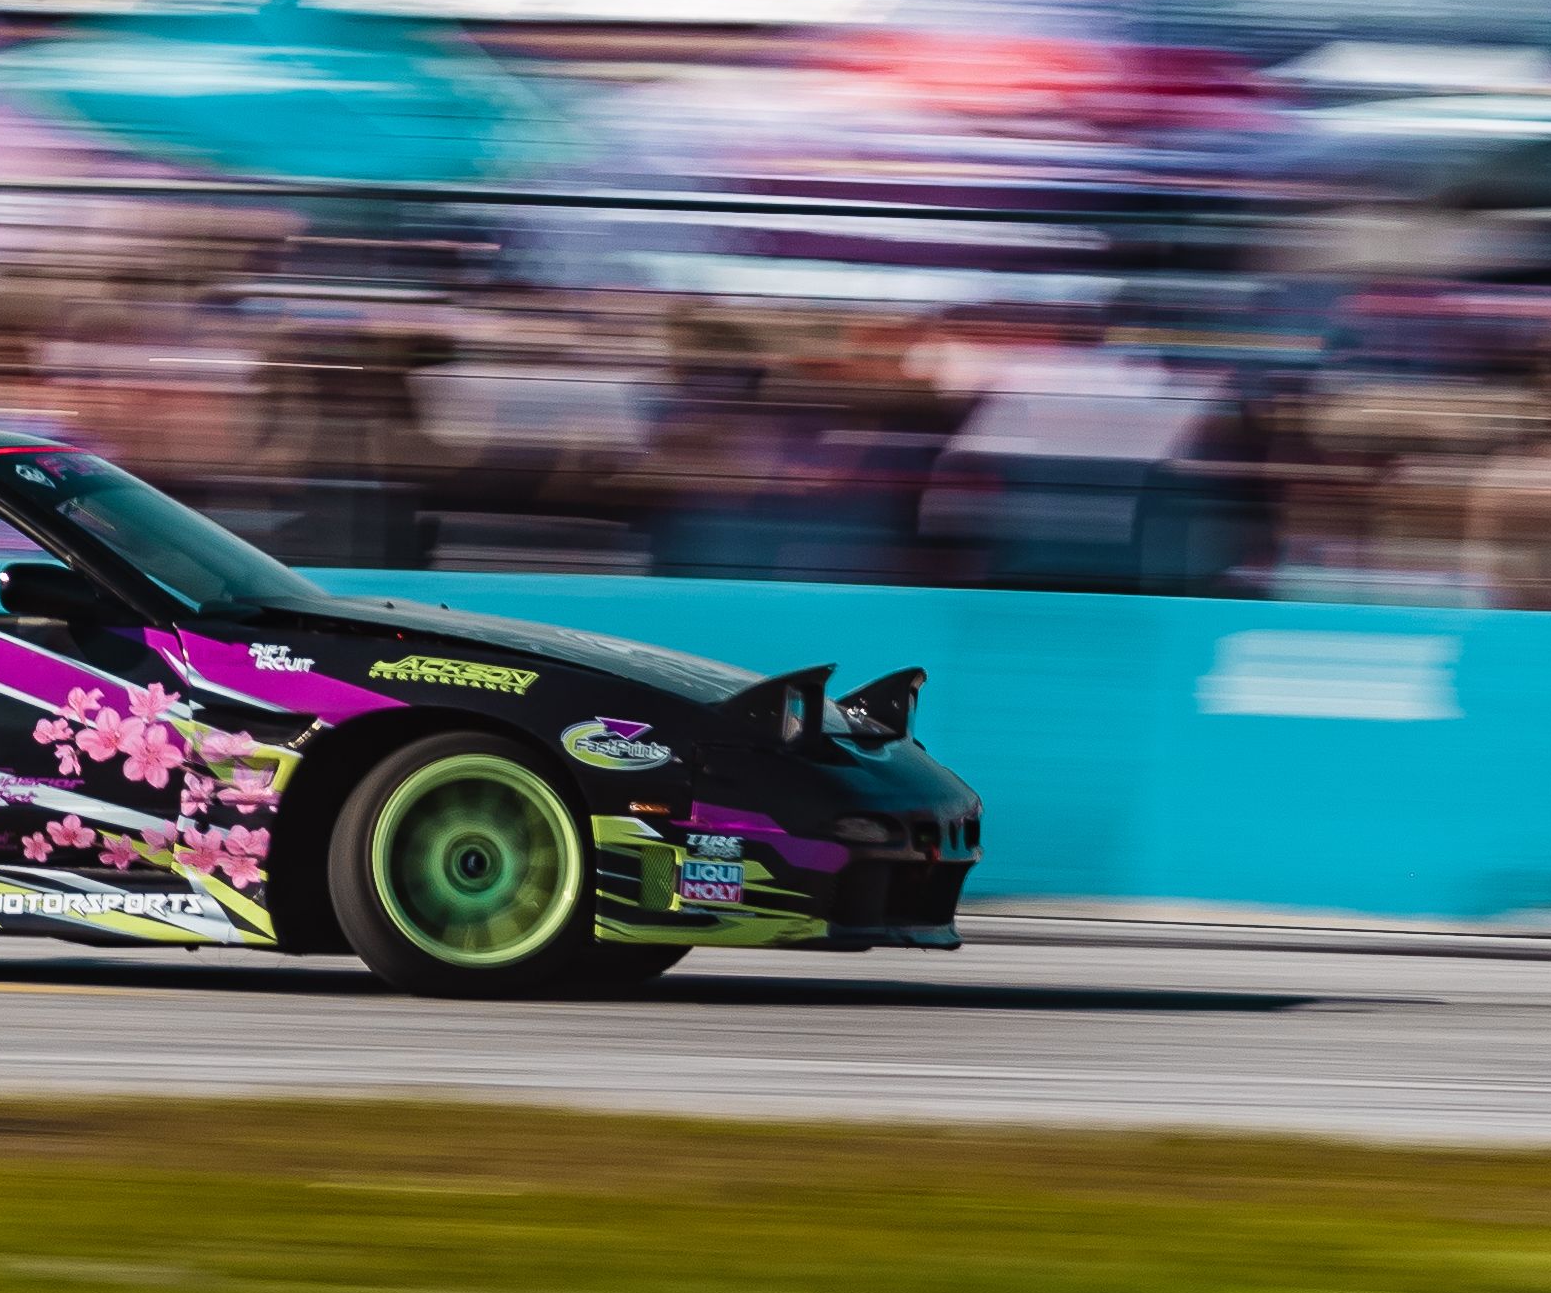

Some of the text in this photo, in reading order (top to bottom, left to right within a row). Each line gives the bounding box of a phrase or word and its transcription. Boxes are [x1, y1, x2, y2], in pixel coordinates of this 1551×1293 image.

[368, 670, 526, 695] PERFORMANCE
[370, 655, 540, 688] JACKSON
[575, 738, 671, 760] FastPrints
[685, 863, 740, 883] LIQUI
[683, 881, 740, 901] MOLY
